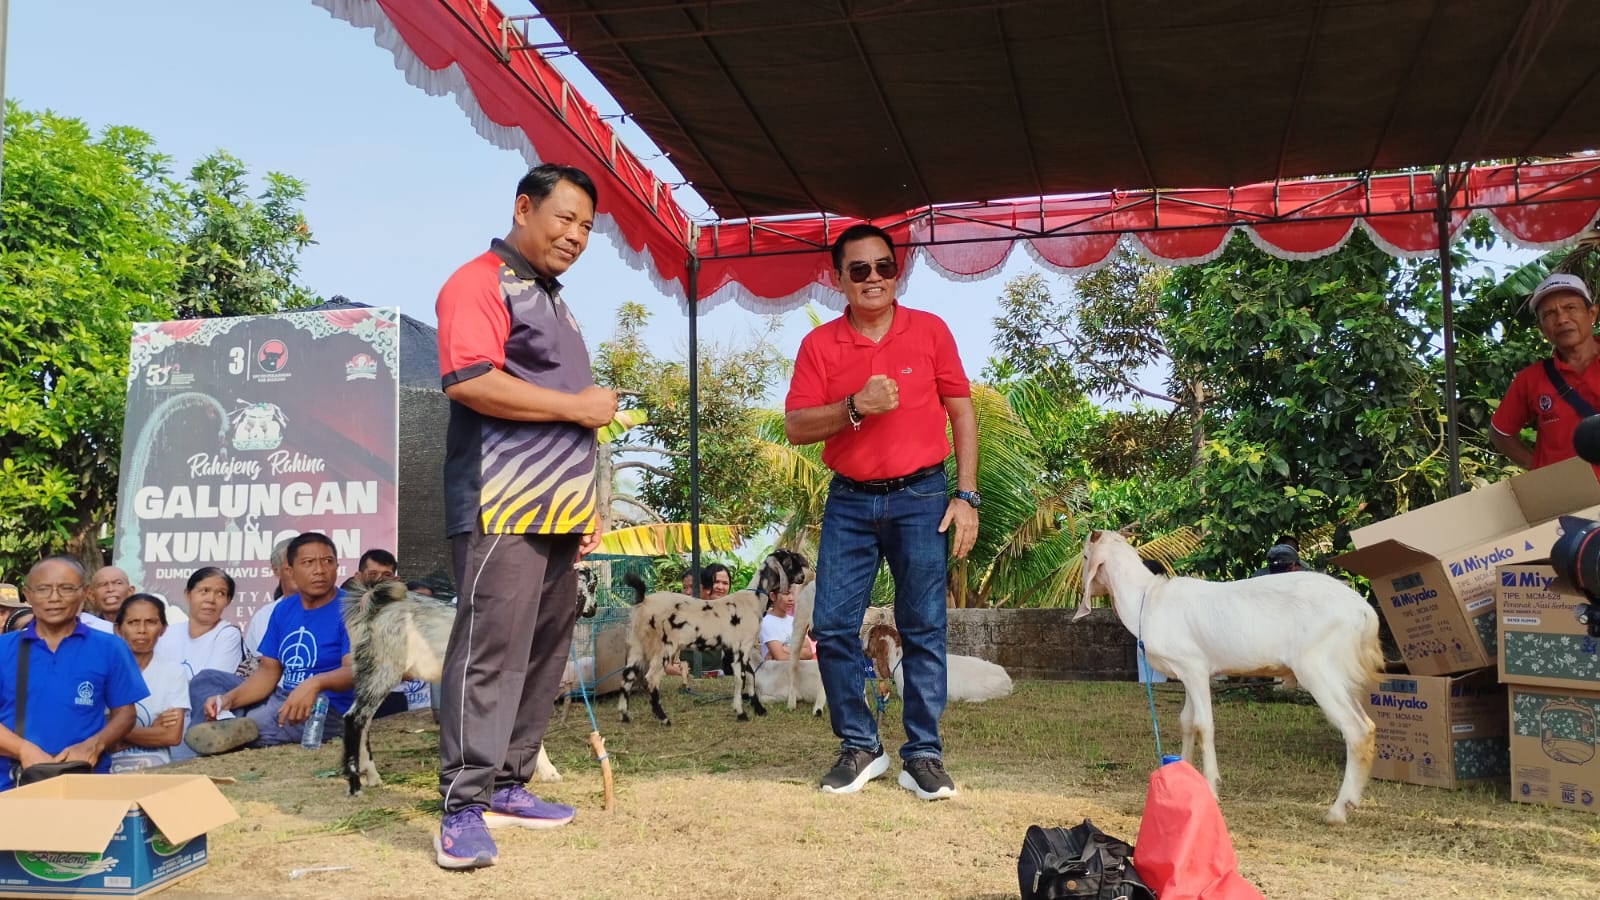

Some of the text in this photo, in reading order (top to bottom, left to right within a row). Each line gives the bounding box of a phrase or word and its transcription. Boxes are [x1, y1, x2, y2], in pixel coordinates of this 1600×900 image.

[229, 347, 244, 375] 3
[187, 450, 325, 481] Rahajeng Rahina
[134, 481, 378, 519] GALUNGAN
[144, 528, 361, 562] KUNINN
[1463, 547, 1514, 573] Miyako
[1520, 572, 1553, 591] Miy
[1400, 588, 1437, 606] Miyako
[1382, 694, 1428, 711] Miyako
